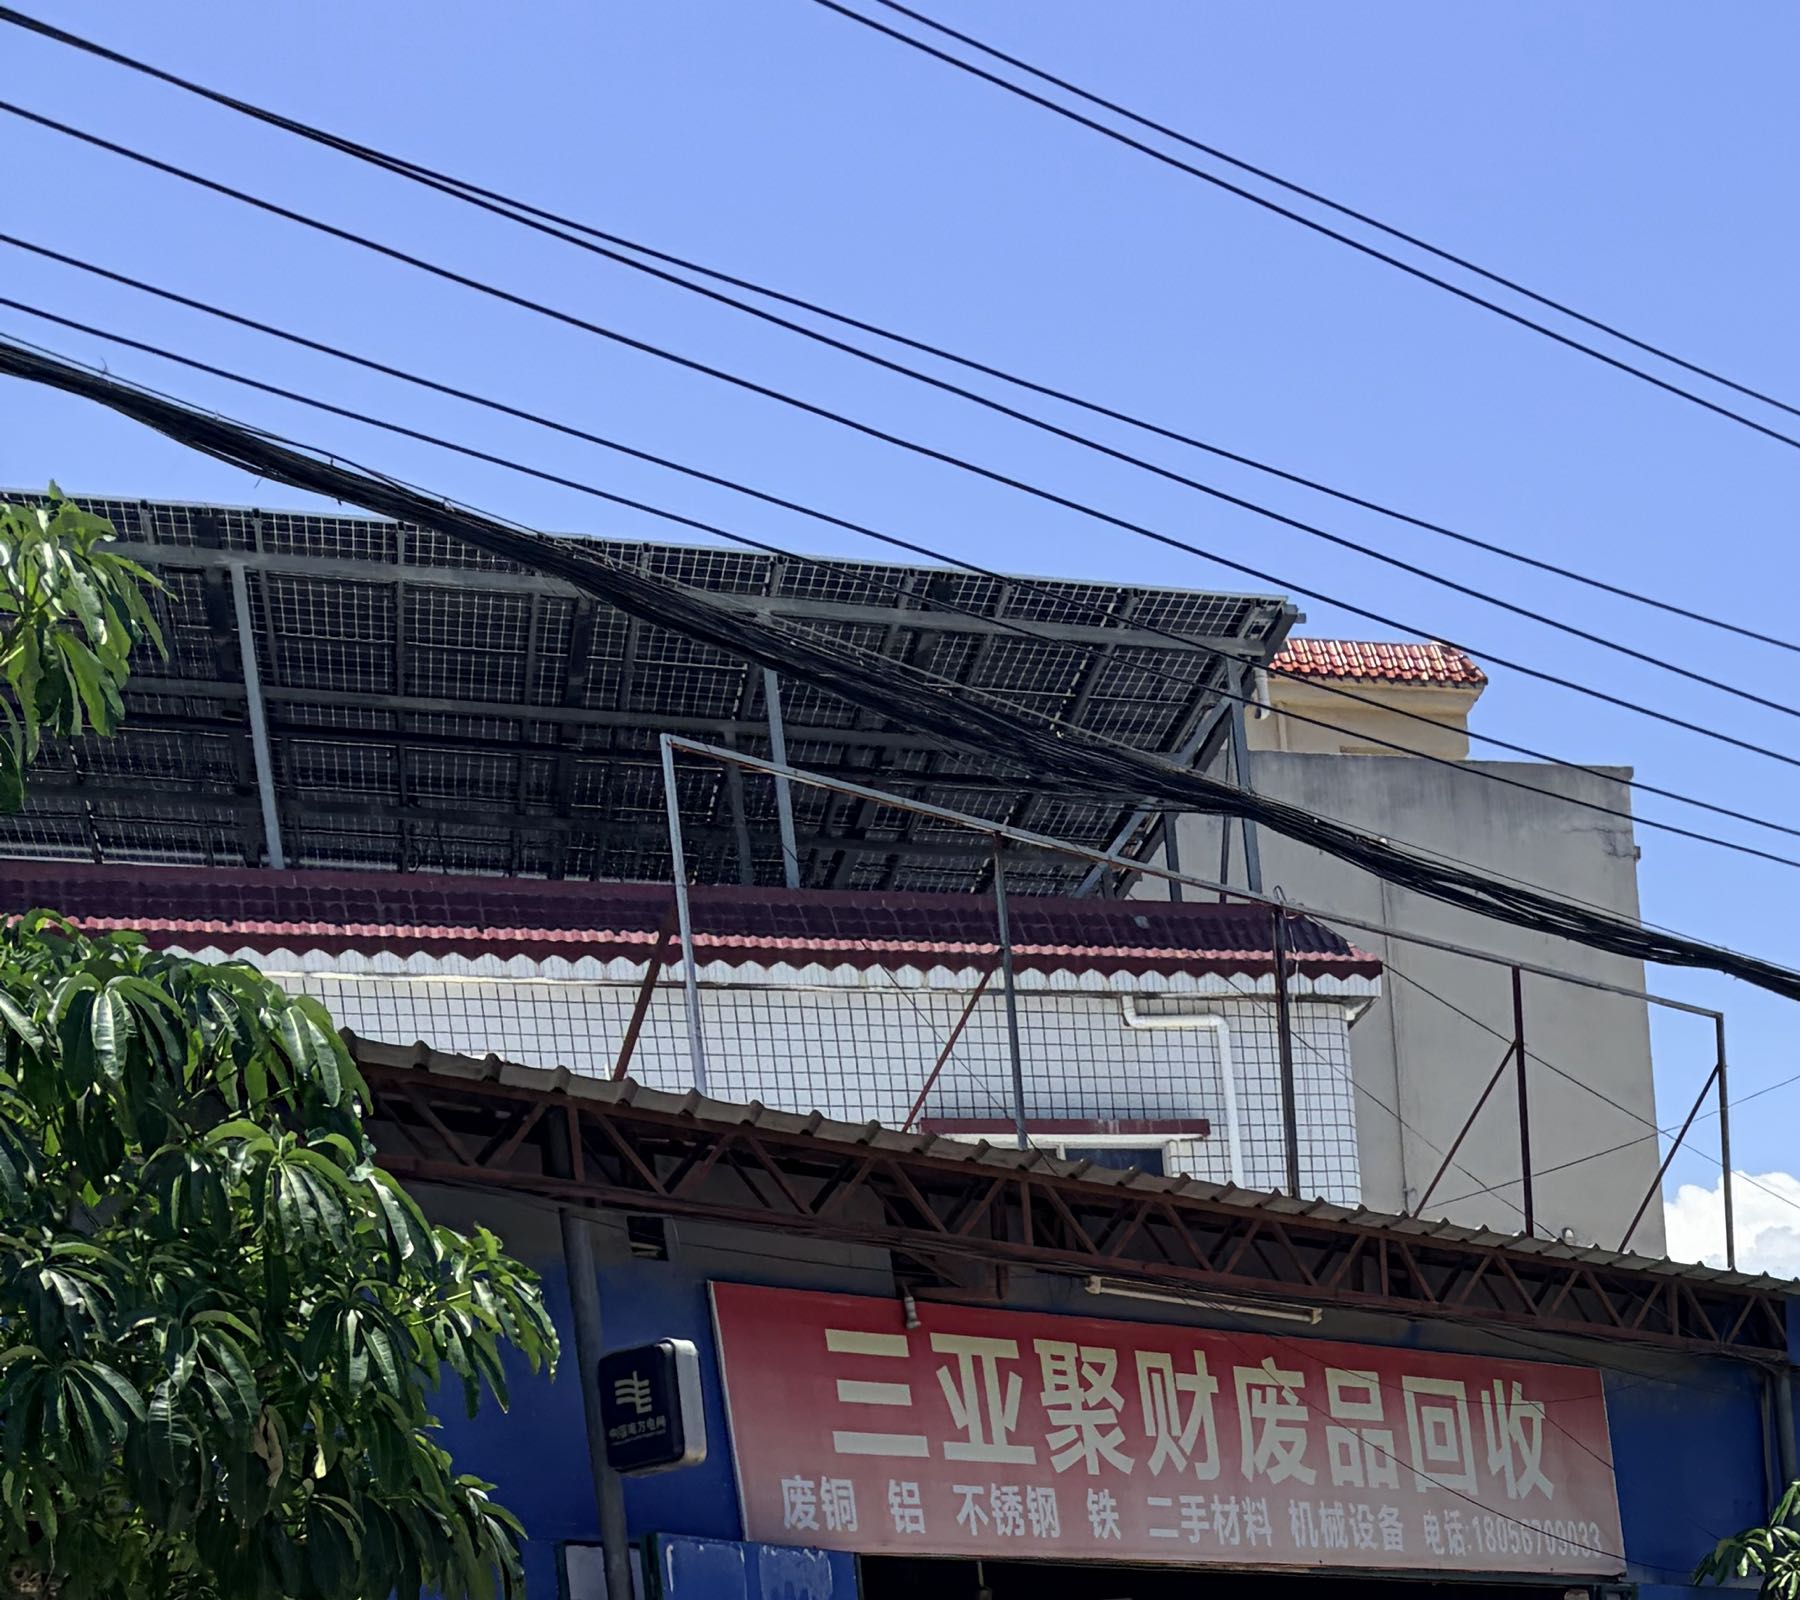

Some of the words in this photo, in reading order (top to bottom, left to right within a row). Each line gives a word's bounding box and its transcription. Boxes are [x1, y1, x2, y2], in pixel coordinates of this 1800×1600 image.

[824, 1326, 1555, 1501] 三亚聚财废品回收
[781, 1475, 859, 1533] 废铜
[888, 1478, 926, 1535] 铝
[952, 1482, 1061, 1539] 不锈钢
[1086, 1488, 1122, 1541] 铁
[1147, 1494, 1273, 1548] 二手材料
[1288, 1498, 1405, 1553] 机械设备
